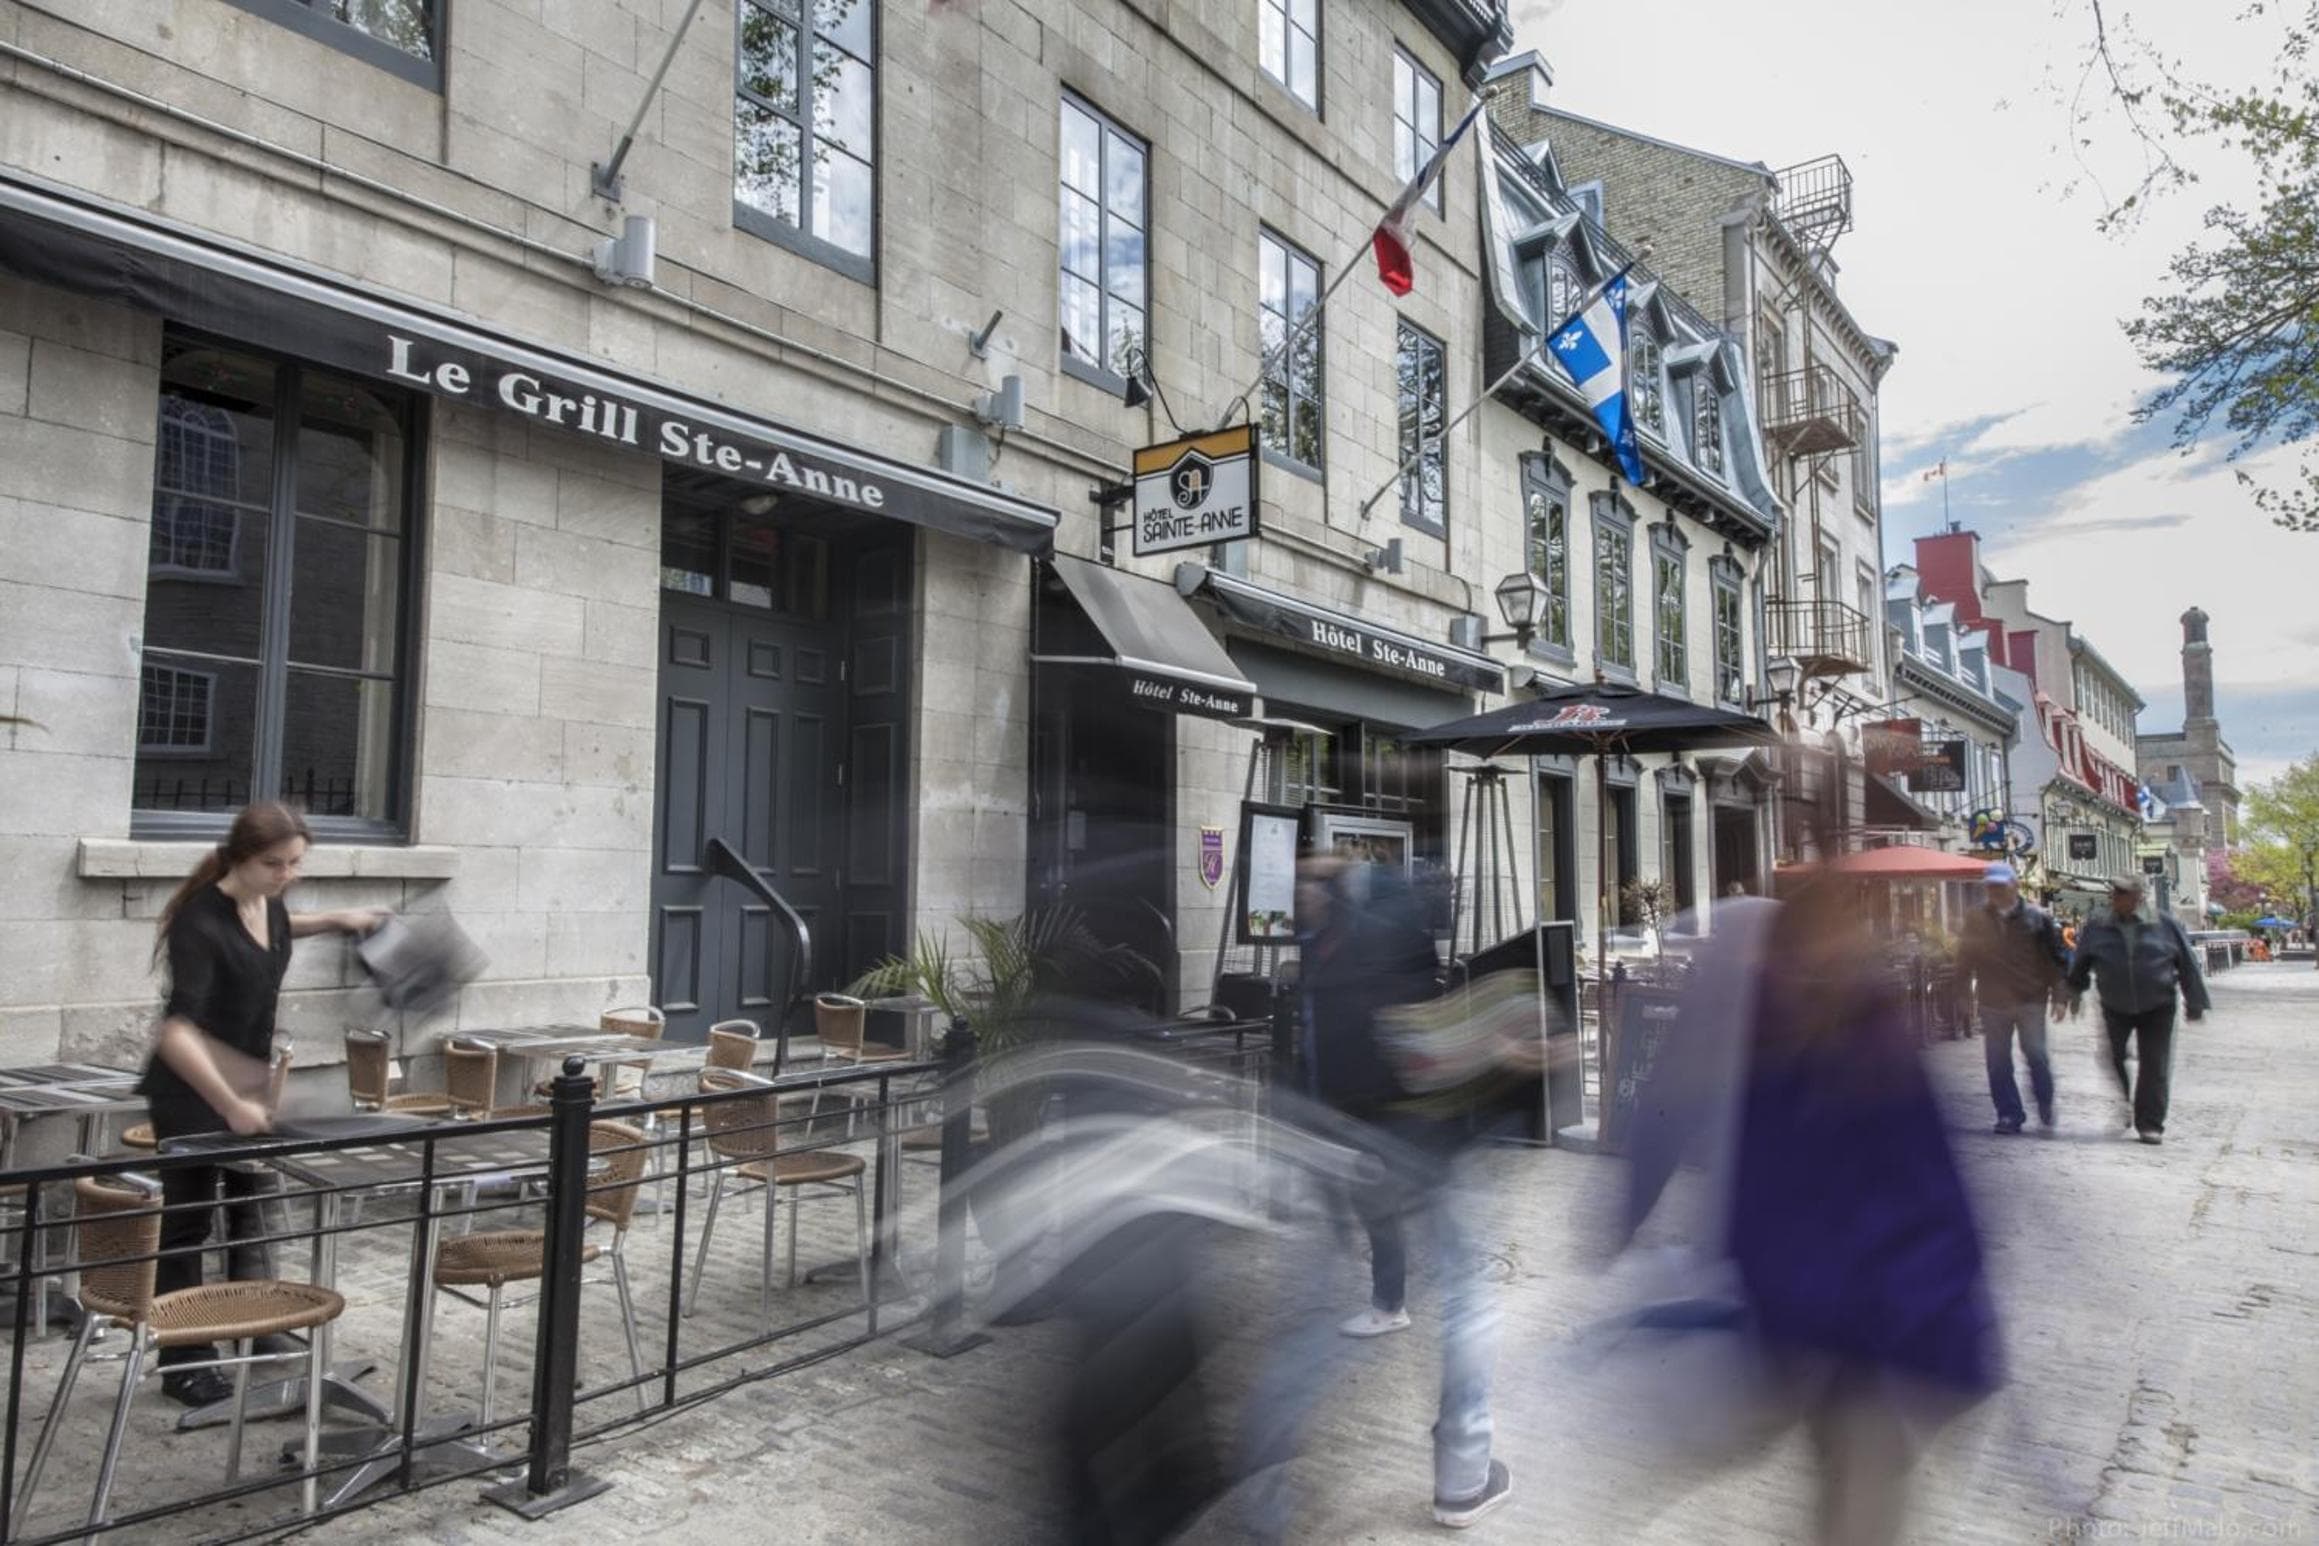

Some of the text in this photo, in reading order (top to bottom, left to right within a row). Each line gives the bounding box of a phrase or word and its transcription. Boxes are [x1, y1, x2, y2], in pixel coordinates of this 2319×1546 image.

[386, 334, 885, 508] Le Grill Ste-Anne
[1143, 508, 1174, 523] HÔTEL
[1143, 506, 1243, 544] SAINTE-ANNE
[1310, 620, 1446, 677] Hôtel Ste-Anne
[1133, 679, 1239, 713] Hôtel Ste-Anne
